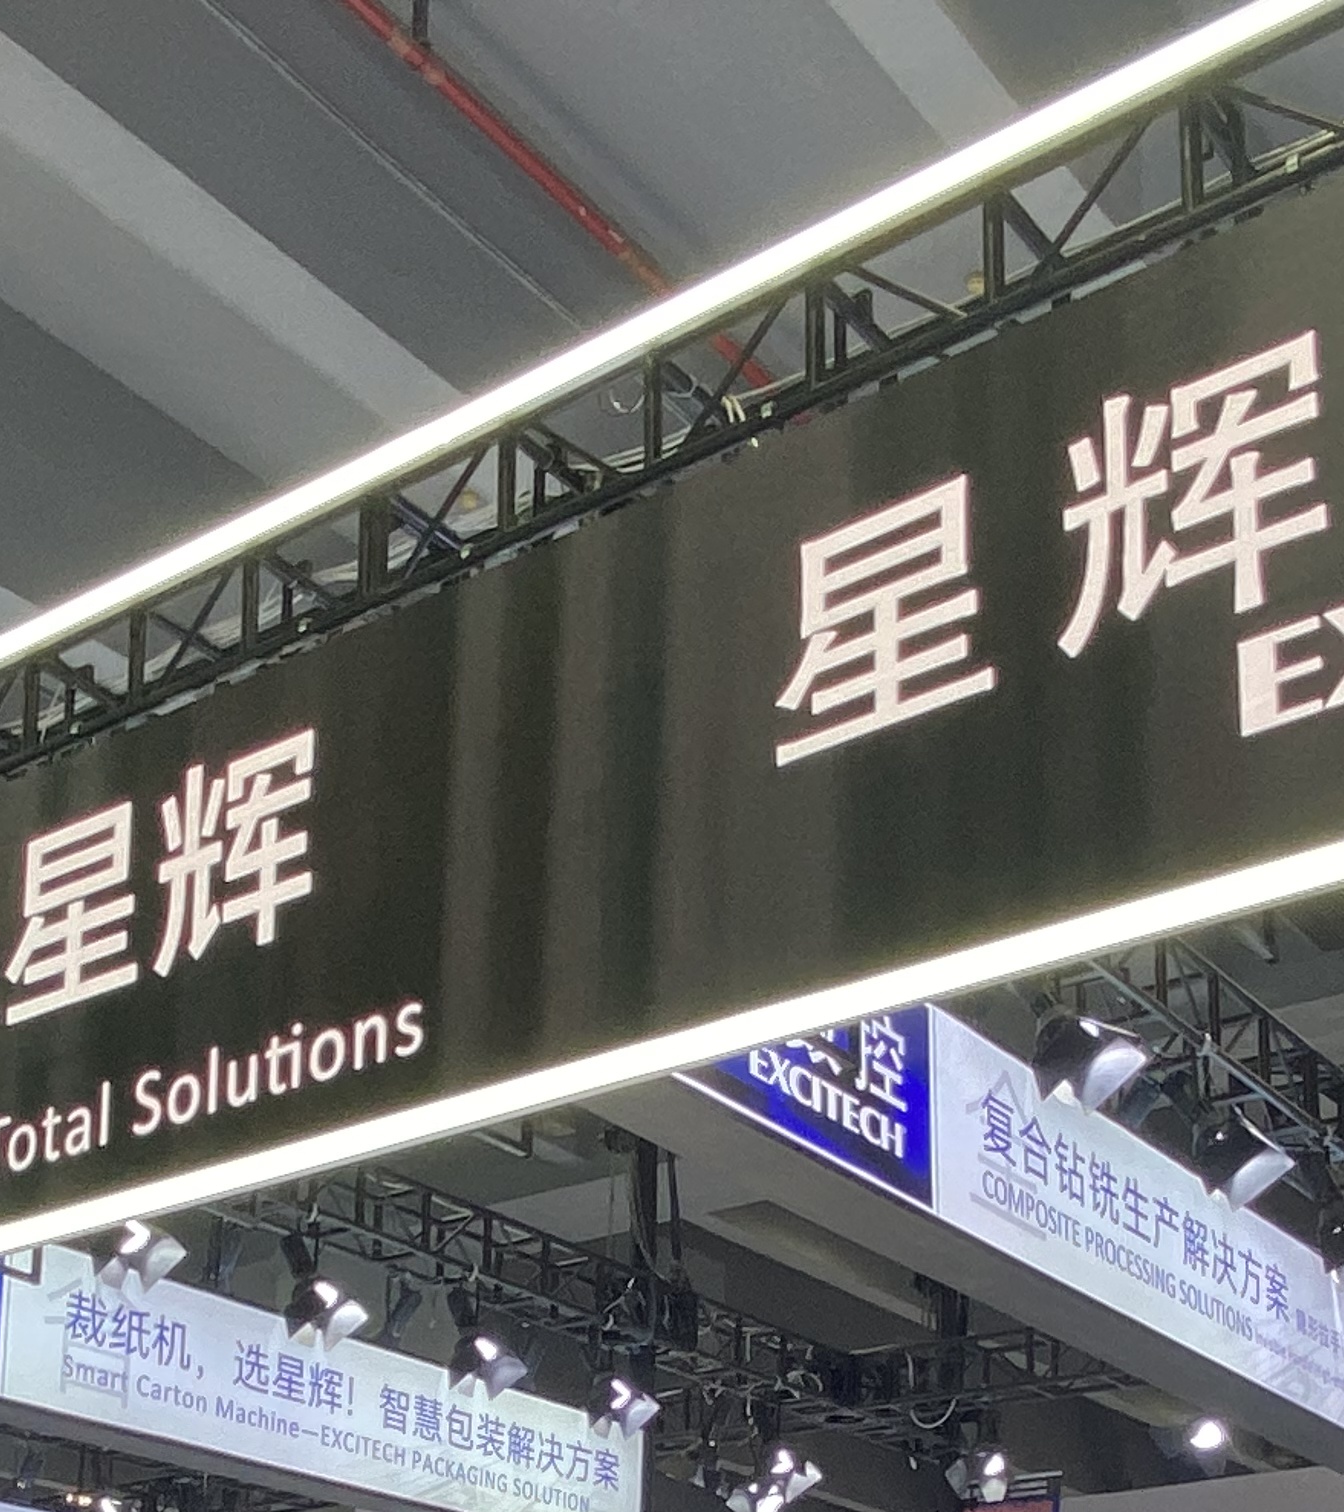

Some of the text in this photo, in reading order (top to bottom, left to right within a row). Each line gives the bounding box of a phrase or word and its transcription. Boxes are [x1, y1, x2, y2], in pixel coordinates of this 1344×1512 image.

[131, 999, 424, 1137] Solutions
[747, 1048, 907, 1160] EXCITECH
[980, 1088, 1291, 1323] 复合钻铣生产解决方案
[981, 1170, 1255, 1343] COMPOSITE PROCESSING SOLUTIONS
[61, 1354, 130, 1394] Smart
[136, 1374, 209, 1414] Carton
[411, 1452, 509, 1495] PACKAGING
